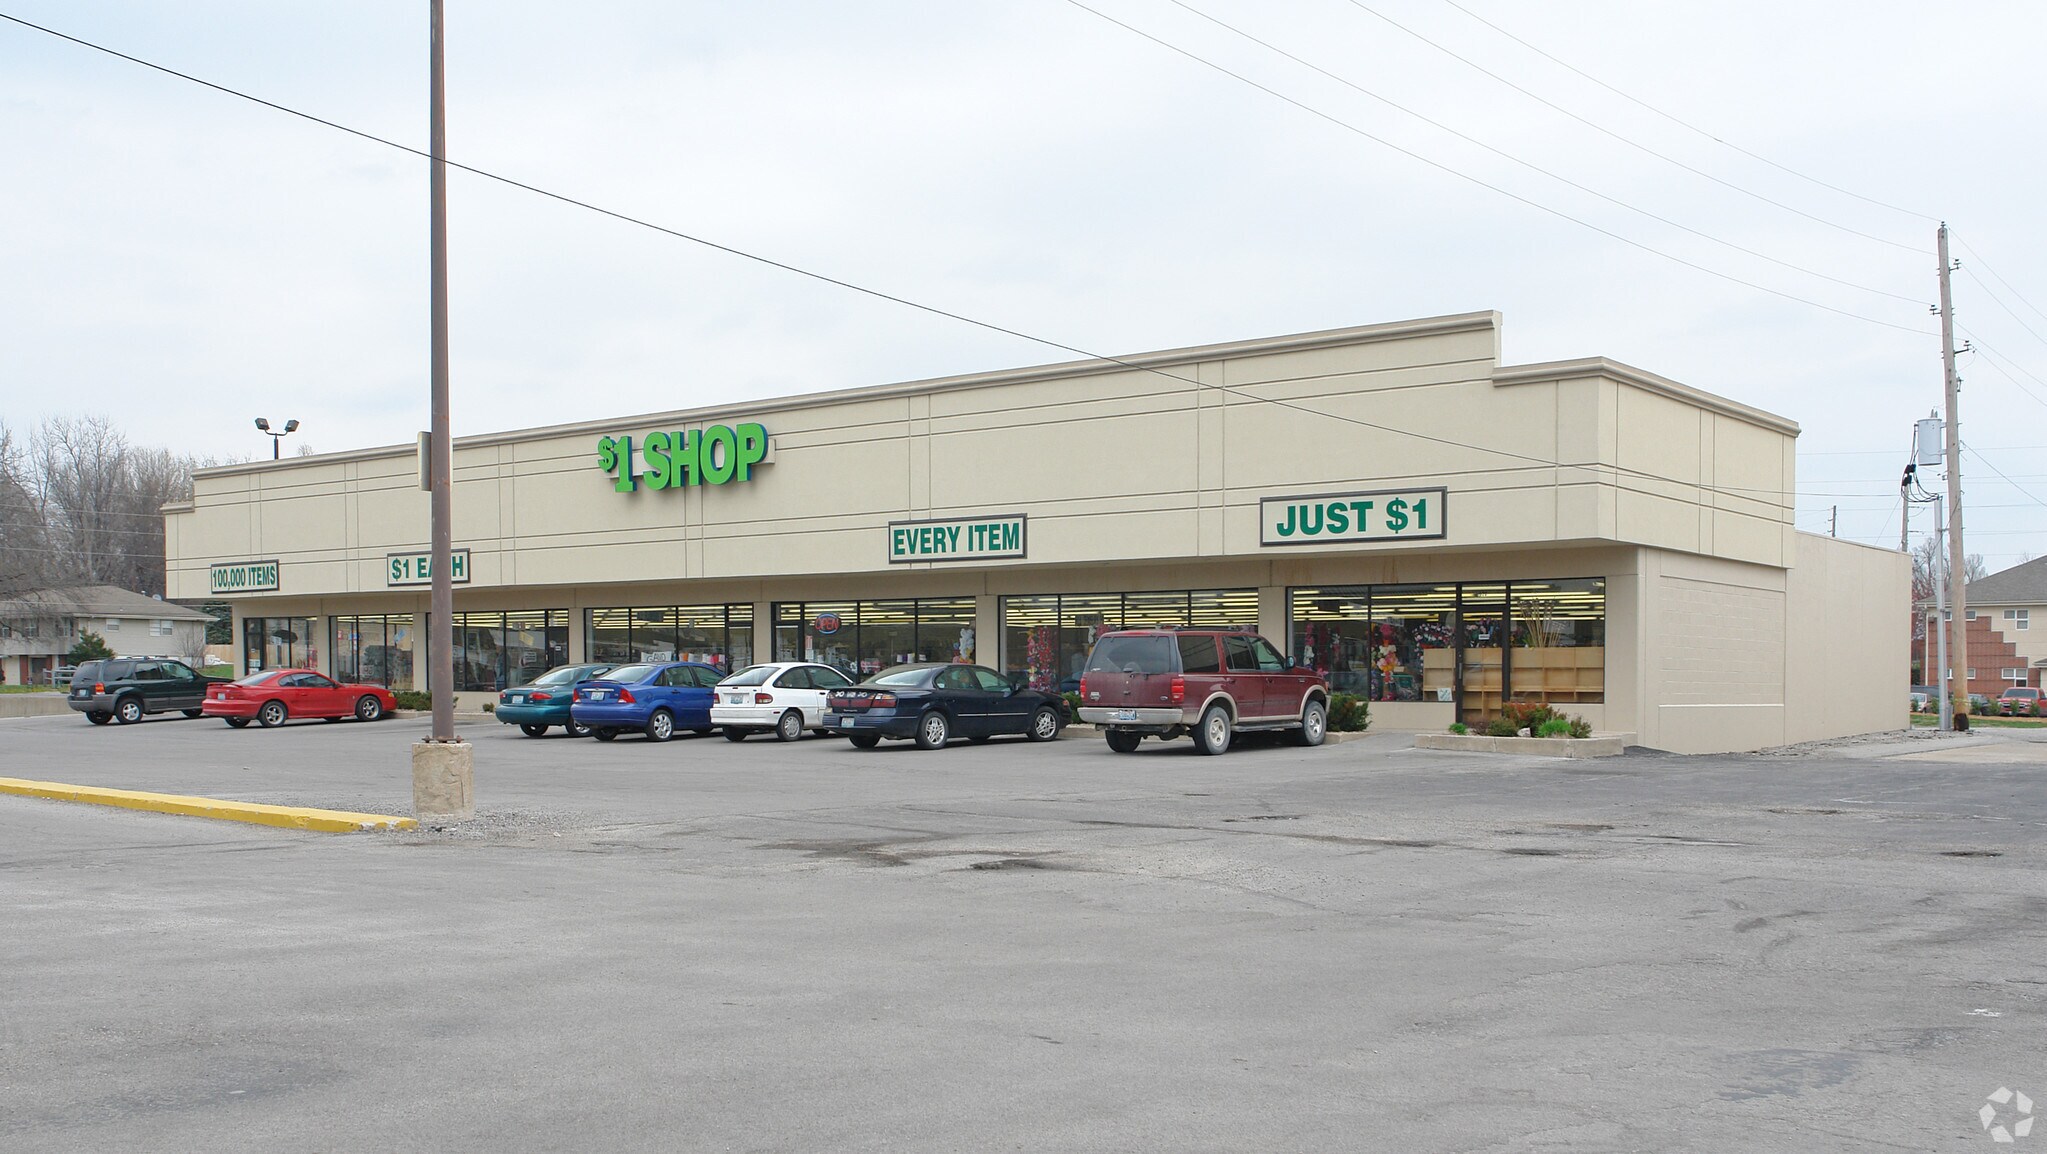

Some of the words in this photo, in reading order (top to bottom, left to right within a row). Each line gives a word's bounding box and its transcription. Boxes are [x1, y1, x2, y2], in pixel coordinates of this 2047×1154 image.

[598, 435, 637, 493] $1
[643, 422, 769, 491] SHOP
[1276, 500, 1374, 537] JUST
[1385, 497, 1427, 534] $1
[893, 526, 961, 555] EVERY
[968, 522, 1020, 552] ITEM
[212, 567, 246, 591] 100,000
[248, 565, 276, 586] ITEMS
[391, 558, 410, 581] $1
[417, 555, 464, 579] EH
[815, 617, 839, 630] OPEN
